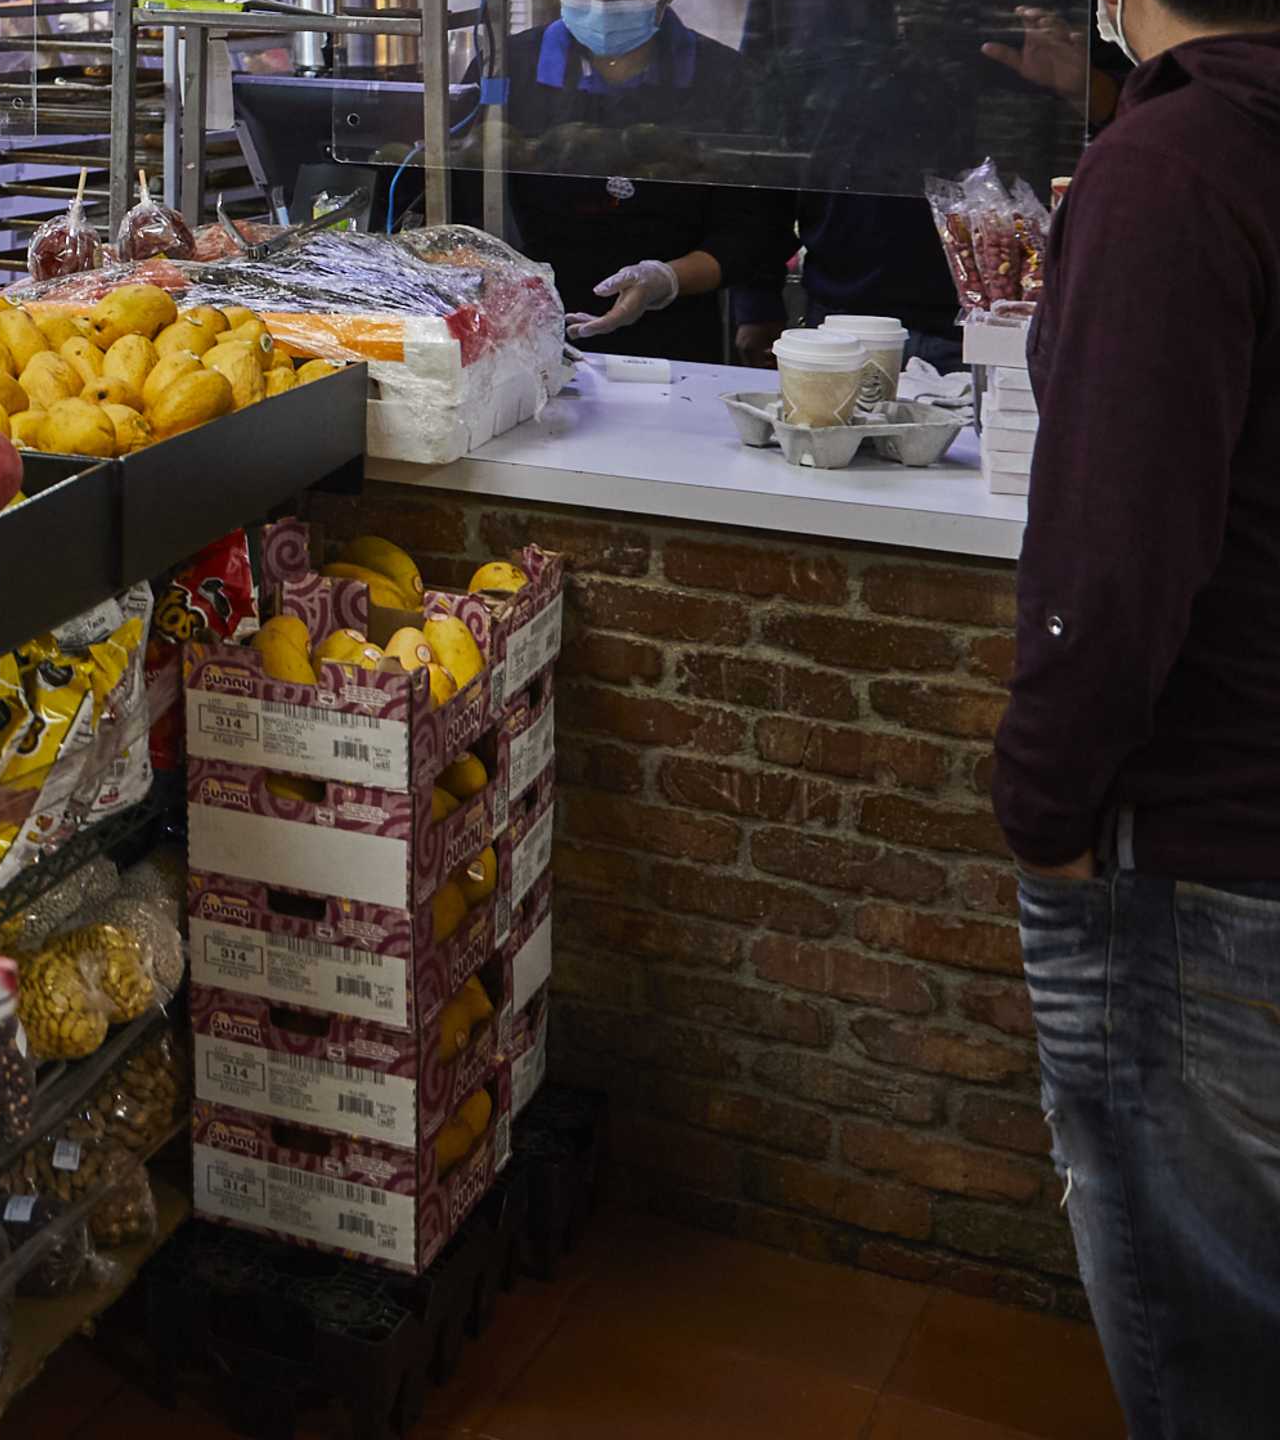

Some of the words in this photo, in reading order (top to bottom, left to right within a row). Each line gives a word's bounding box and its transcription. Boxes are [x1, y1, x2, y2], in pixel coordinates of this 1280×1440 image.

[215, 716, 242, 730] 314
[220, 948, 247, 963] 314
[222, 1064, 249, 1079] 314
[223, 1179, 248, 1194] 314
